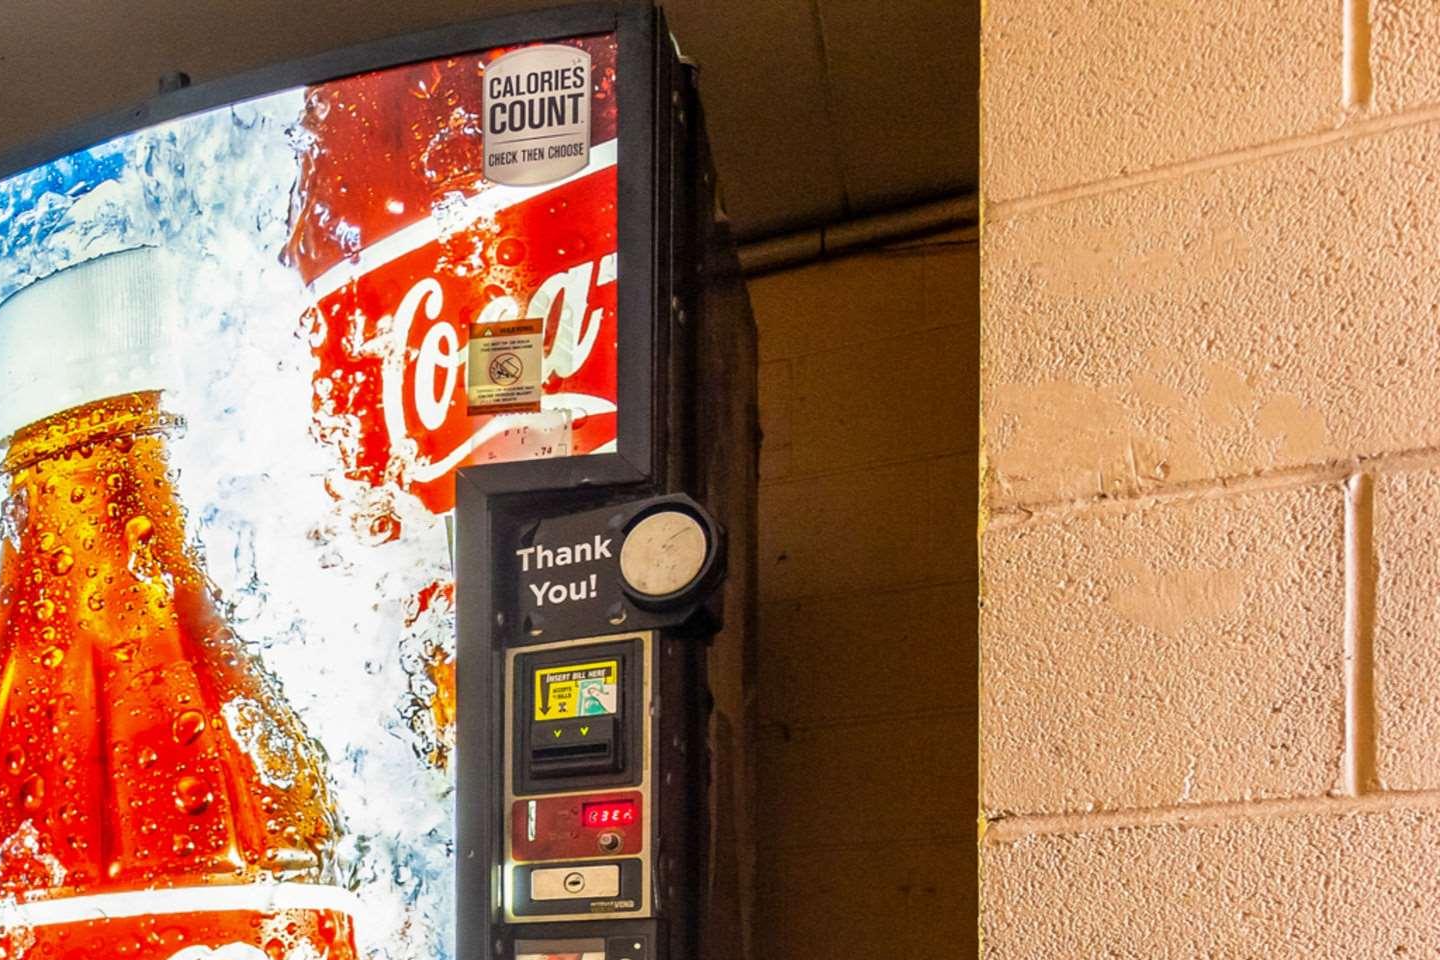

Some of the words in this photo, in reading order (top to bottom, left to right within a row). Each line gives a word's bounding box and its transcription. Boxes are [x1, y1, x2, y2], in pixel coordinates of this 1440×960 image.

[488, 66, 585, 100] CALORIES
[488, 92, 585, 135] COUNT
[488, 150, 518, 168] CHECK
[521, 147, 545, 162] THEN
[547, 142, 585, 159] CHOOSE
[516, 535, 613, 572] Thank
[529, 574, 598, 607] You!
[546, 672, 570, 683] INSERT
[572, 670, 586, 681] BILL
[588, 668, 606, 679] HERE
